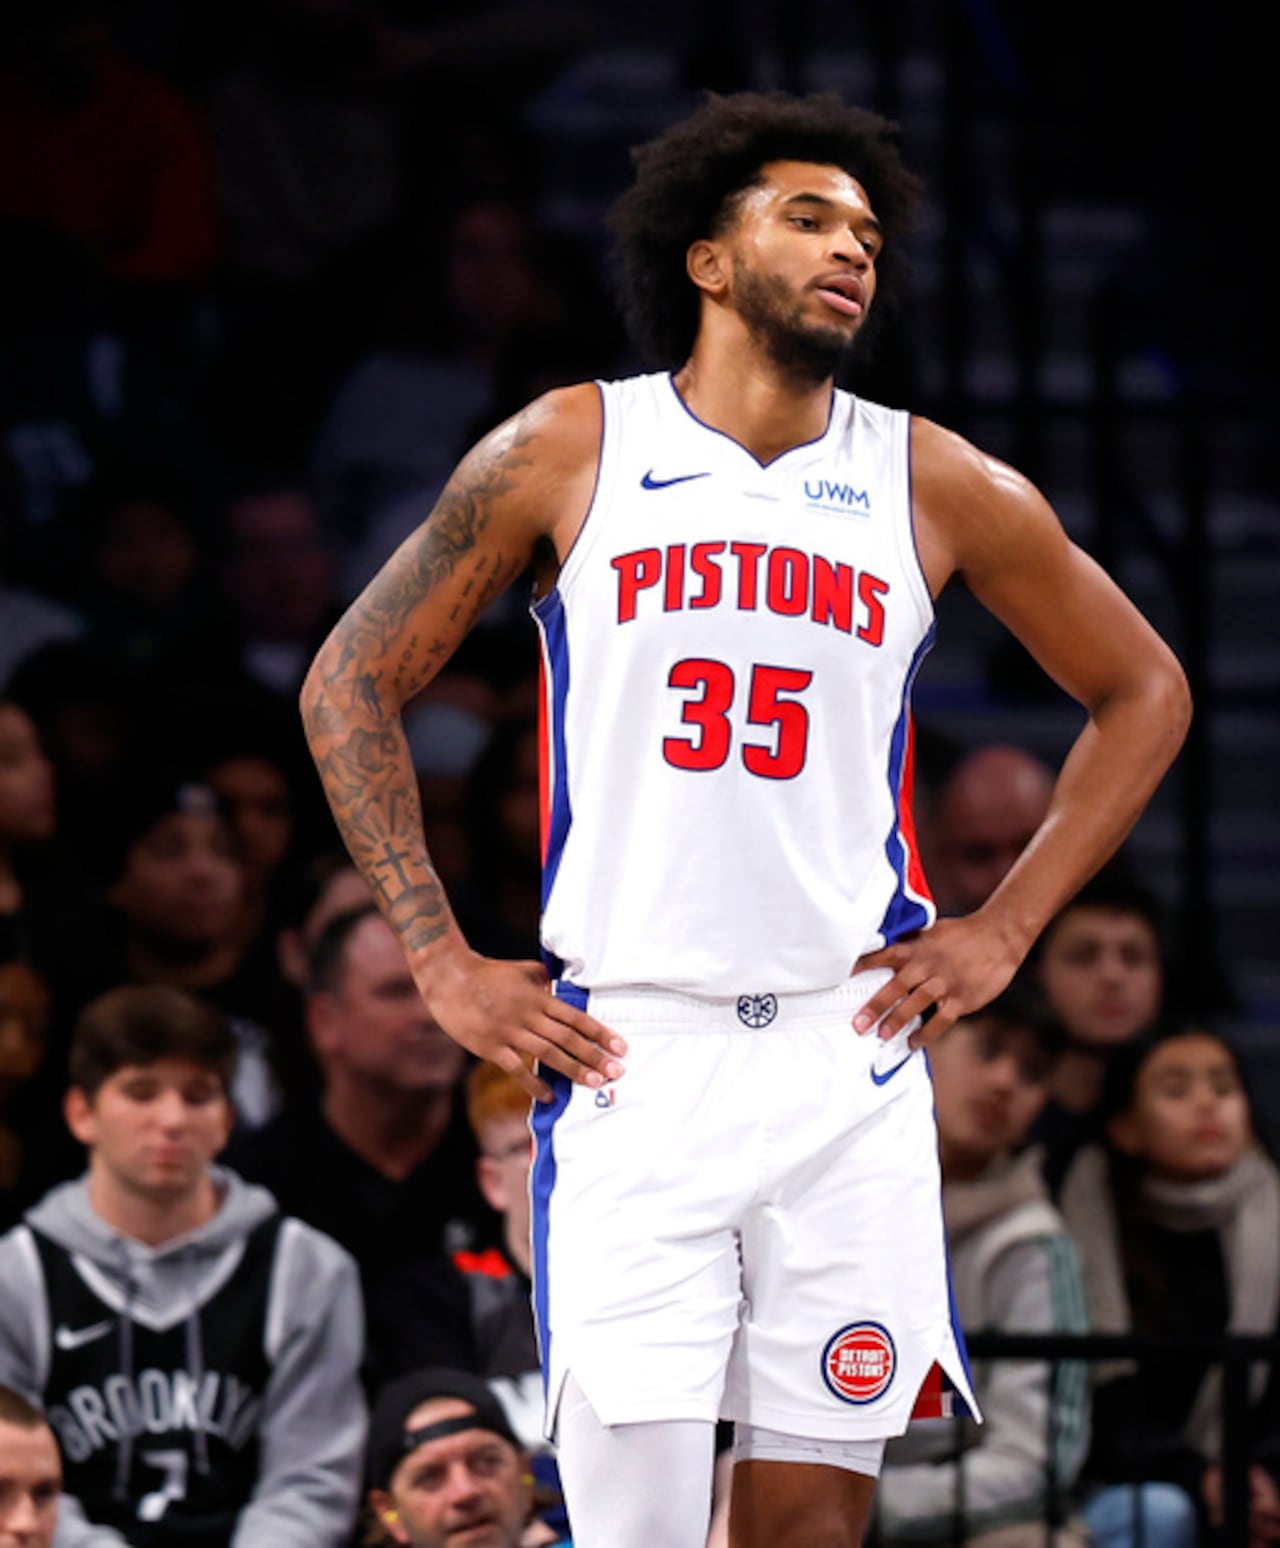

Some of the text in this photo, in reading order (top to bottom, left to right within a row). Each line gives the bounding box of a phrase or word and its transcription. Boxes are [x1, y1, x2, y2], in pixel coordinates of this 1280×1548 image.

[804, 479, 871, 509] UWM
[610, 540, 890, 648] PISTONS
[661, 657, 814, 781] 35
